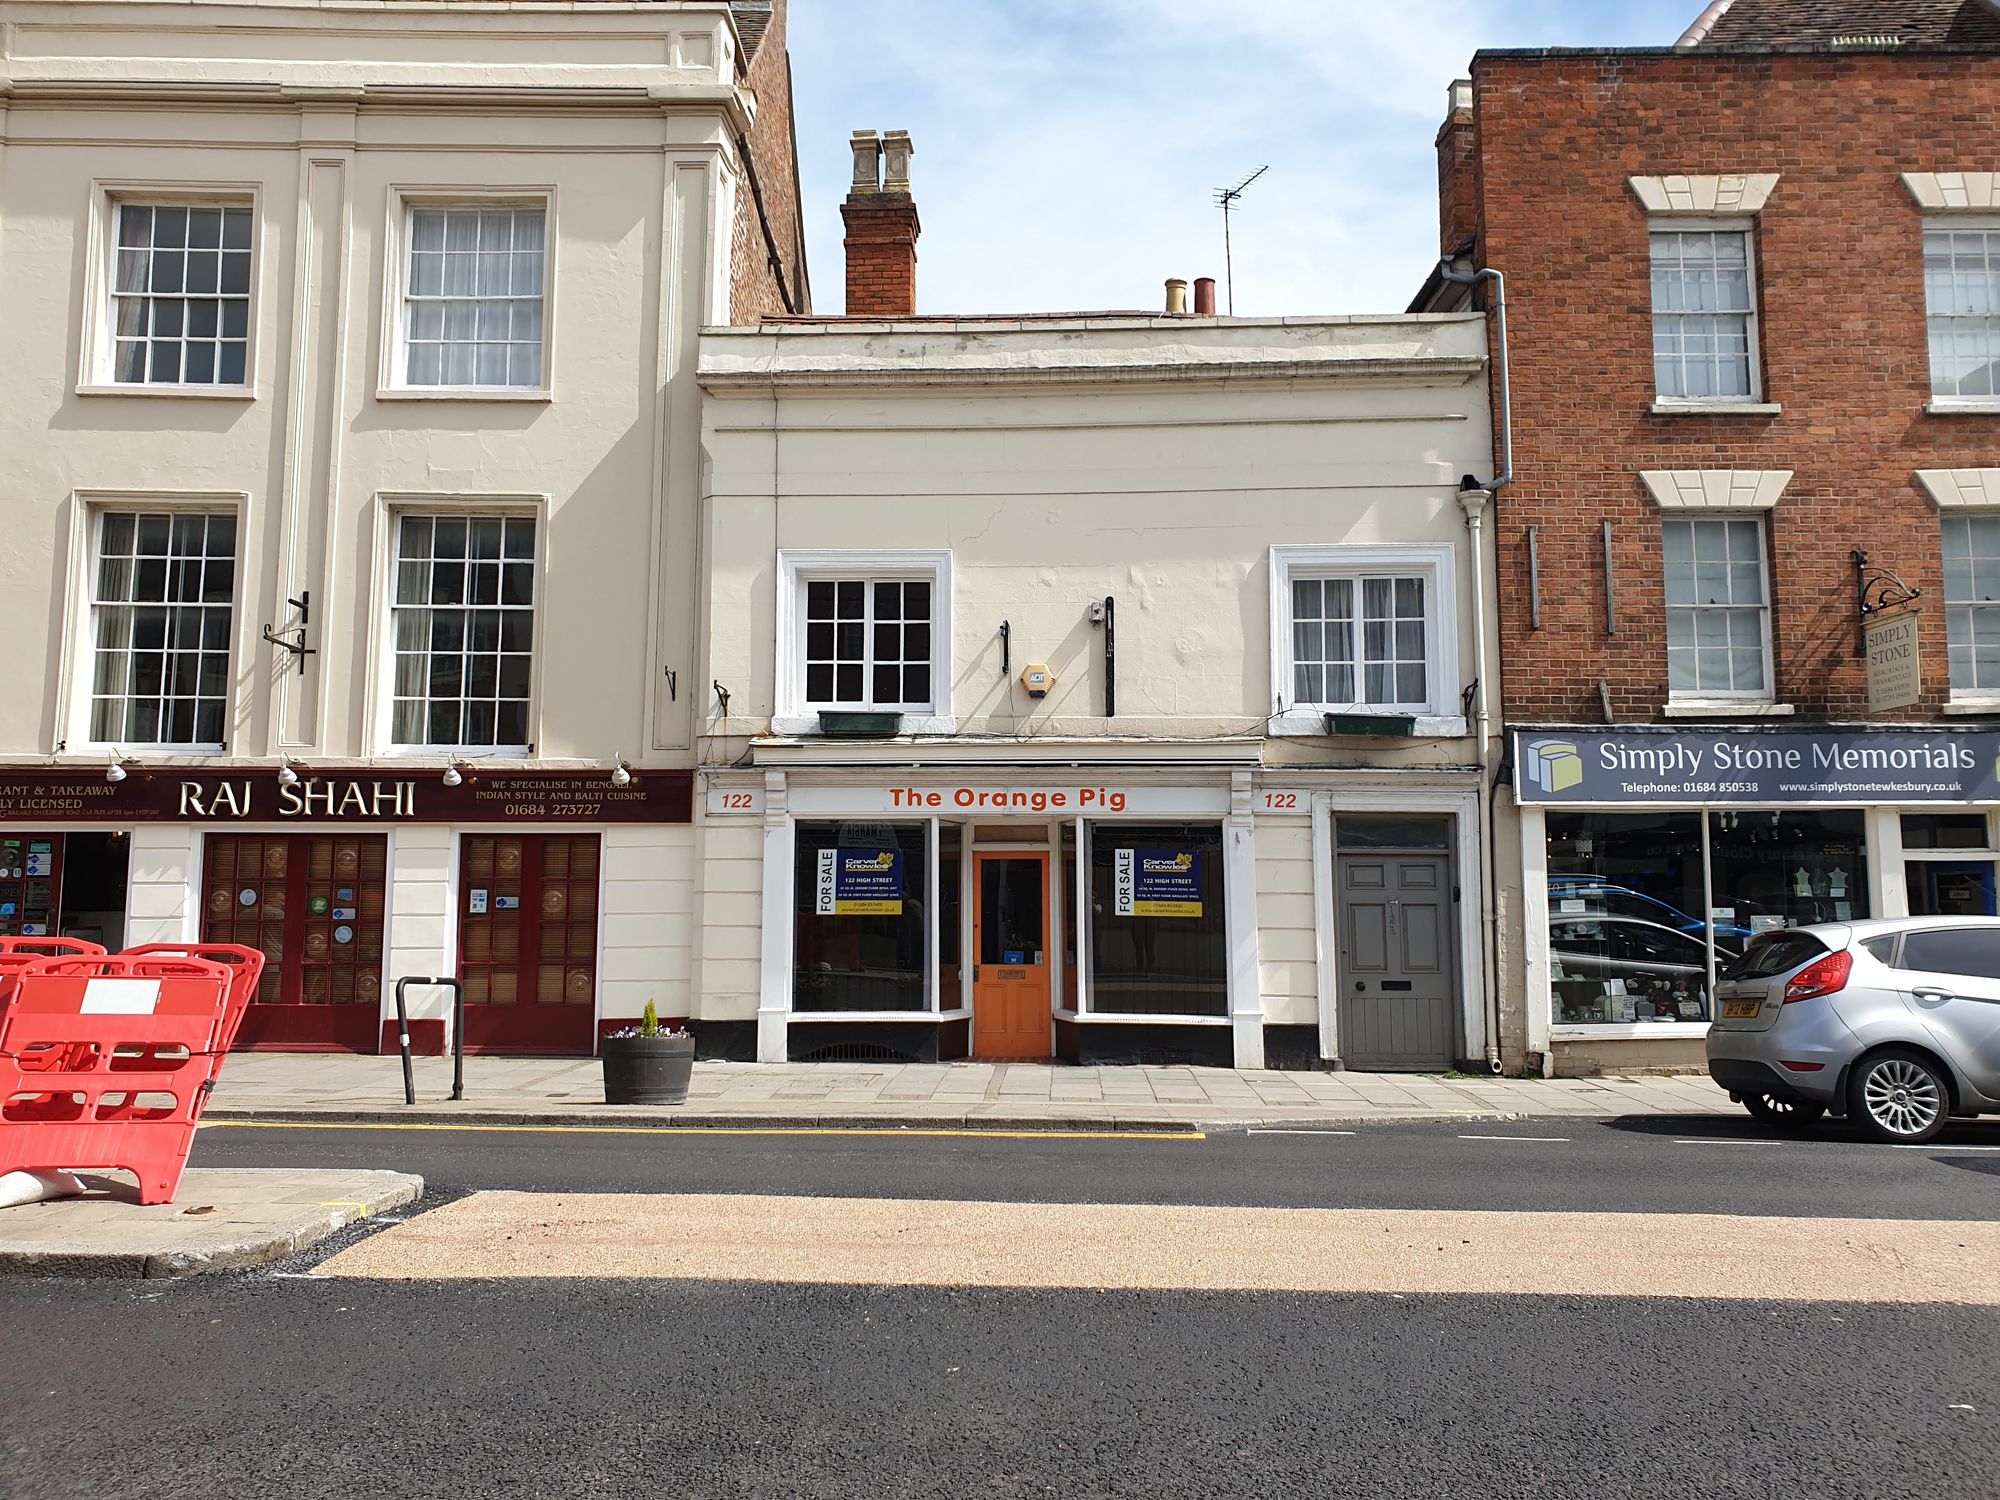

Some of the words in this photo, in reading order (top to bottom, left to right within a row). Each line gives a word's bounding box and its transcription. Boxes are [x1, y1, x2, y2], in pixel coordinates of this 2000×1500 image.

[1868, 623, 1911, 648] SIMPLY
[1871, 643, 1911, 666] STONE
[1600, 742, 1703, 776] Simply
[1714, 742, 1800, 770] Stone
[1812, 742, 1976, 770] Memorials
[0, 786, 29, 796] ANT
[34, 786, 45, 796] &
[50, 786, 117, 796] TAKEAWAY
[491, 780, 506, 789] WE
[510, 781, 568, 789] SPECIALISE
[571, 781, 582, 789] IN
[1621, 782, 1681, 794] Telephone:
[1683, 782, 1716, 793] 01684
[1719, 782, 1759, 793] 850538
[1779, 781, 1962, 794] www.simplystonetewkesbury.co.uk
[19, 799, 83, 809] LICENSED
[178, 780, 252, 817] RAJ
[278, 781, 416, 816] SHAHI
[476, 791, 511, 800] INDIAN
[515, 791, 546, 800] STYLE
[549, 791, 572, 800] AND
[575, 792, 604, 800] BALTI
[607, 792, 647, 800] CUISINE
[722, 793, 753, 808] 122
[889, 787, 942, 807] The
[953, 788, 1067, 812] Orange
[1079, 787, 1126, 812] Pig
[1264, 793, 1297, 808] 122
[505, 804, 546, 815] 01684
[552, 804, 601, 815] 273727
[821, 852, 833, 884] SALE
[1119, 852, 1130, 884] SALE
[820, 887, 832, 912] FOR
[1120, 887, 1130, 912] FOR
